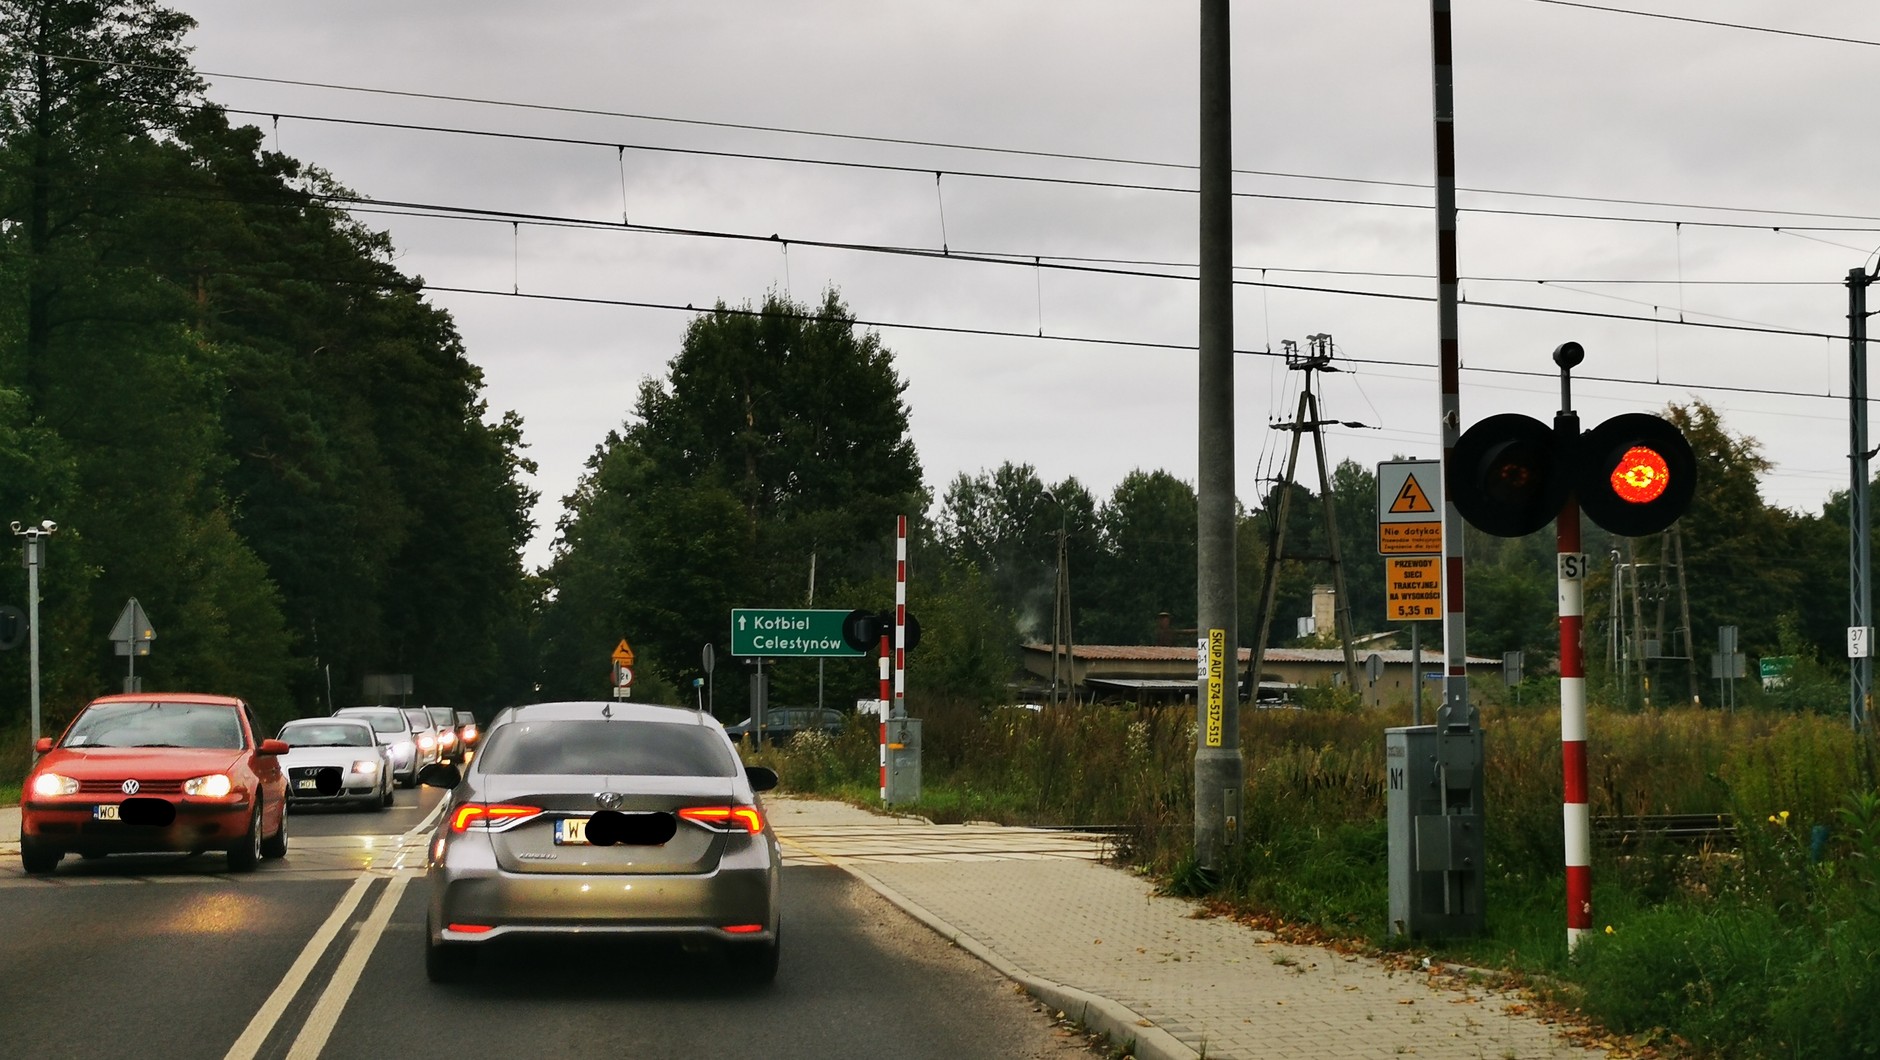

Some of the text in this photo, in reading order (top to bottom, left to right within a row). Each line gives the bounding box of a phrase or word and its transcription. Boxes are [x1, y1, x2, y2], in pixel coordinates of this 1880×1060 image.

[1384, 527, 1399, 536] Nie
[1394, 559, 1433, 568] PRZEWODY
[1565, 555, 1586, 578] S1
[1403, 570, 1423, 579] SIECI
[1393, 581, 1438, 590] TRAKCYJNEJ
[1389, 591, 1441, 601] NA WYSOKOŚCI
[1398, 605, 1434, 616] 5,35 m
[754, 616, 810, 630] Kołbiel
[1851, 629, 1863, 642] 37
[753, 635, 841, 653] Celestynów
[1853, 643, 1859, 655] 5
[1209, 632, 1223, 744] SKUP AUT 574-517-515
[1390, 767, 1403, 790] N1
